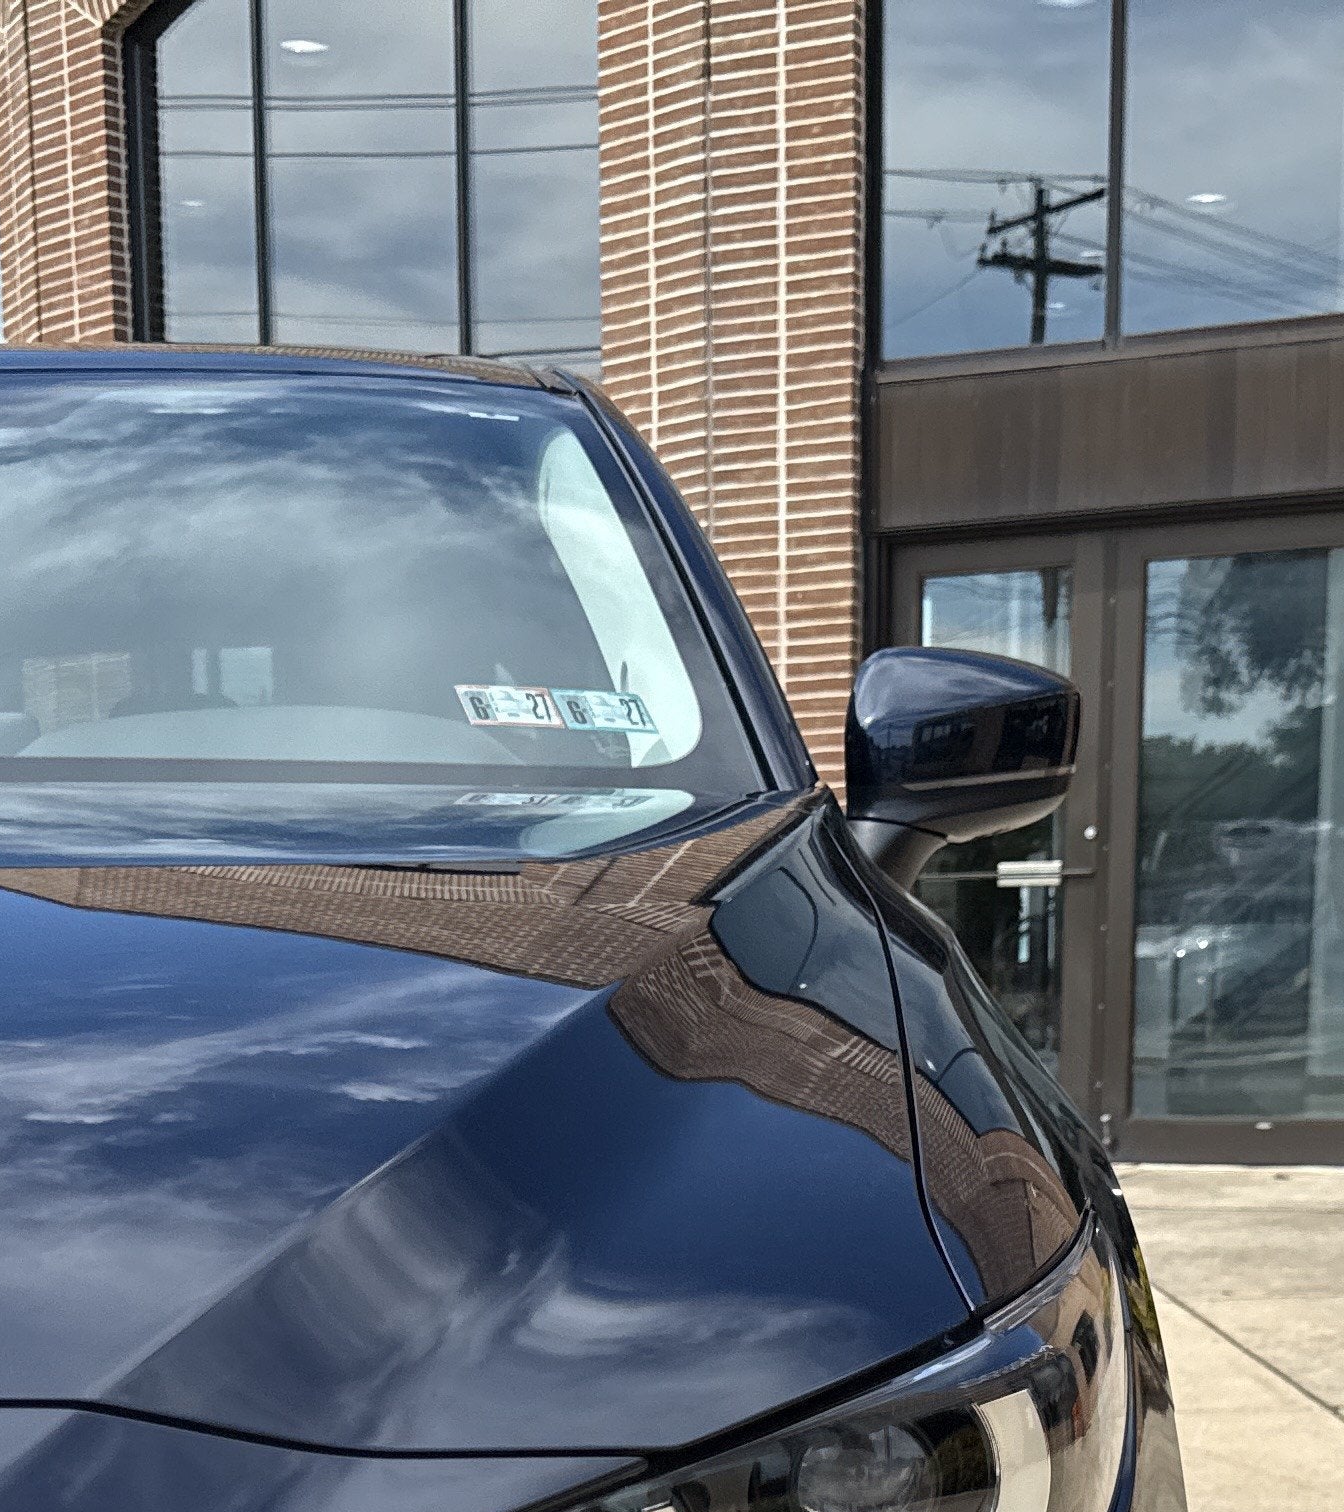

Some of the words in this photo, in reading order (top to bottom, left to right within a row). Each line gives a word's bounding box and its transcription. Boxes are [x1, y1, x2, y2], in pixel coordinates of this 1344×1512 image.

[468, 696, 489, 721] 6
[525, 693, 552, 722] 27
[619, 699, 647, 727] 27
